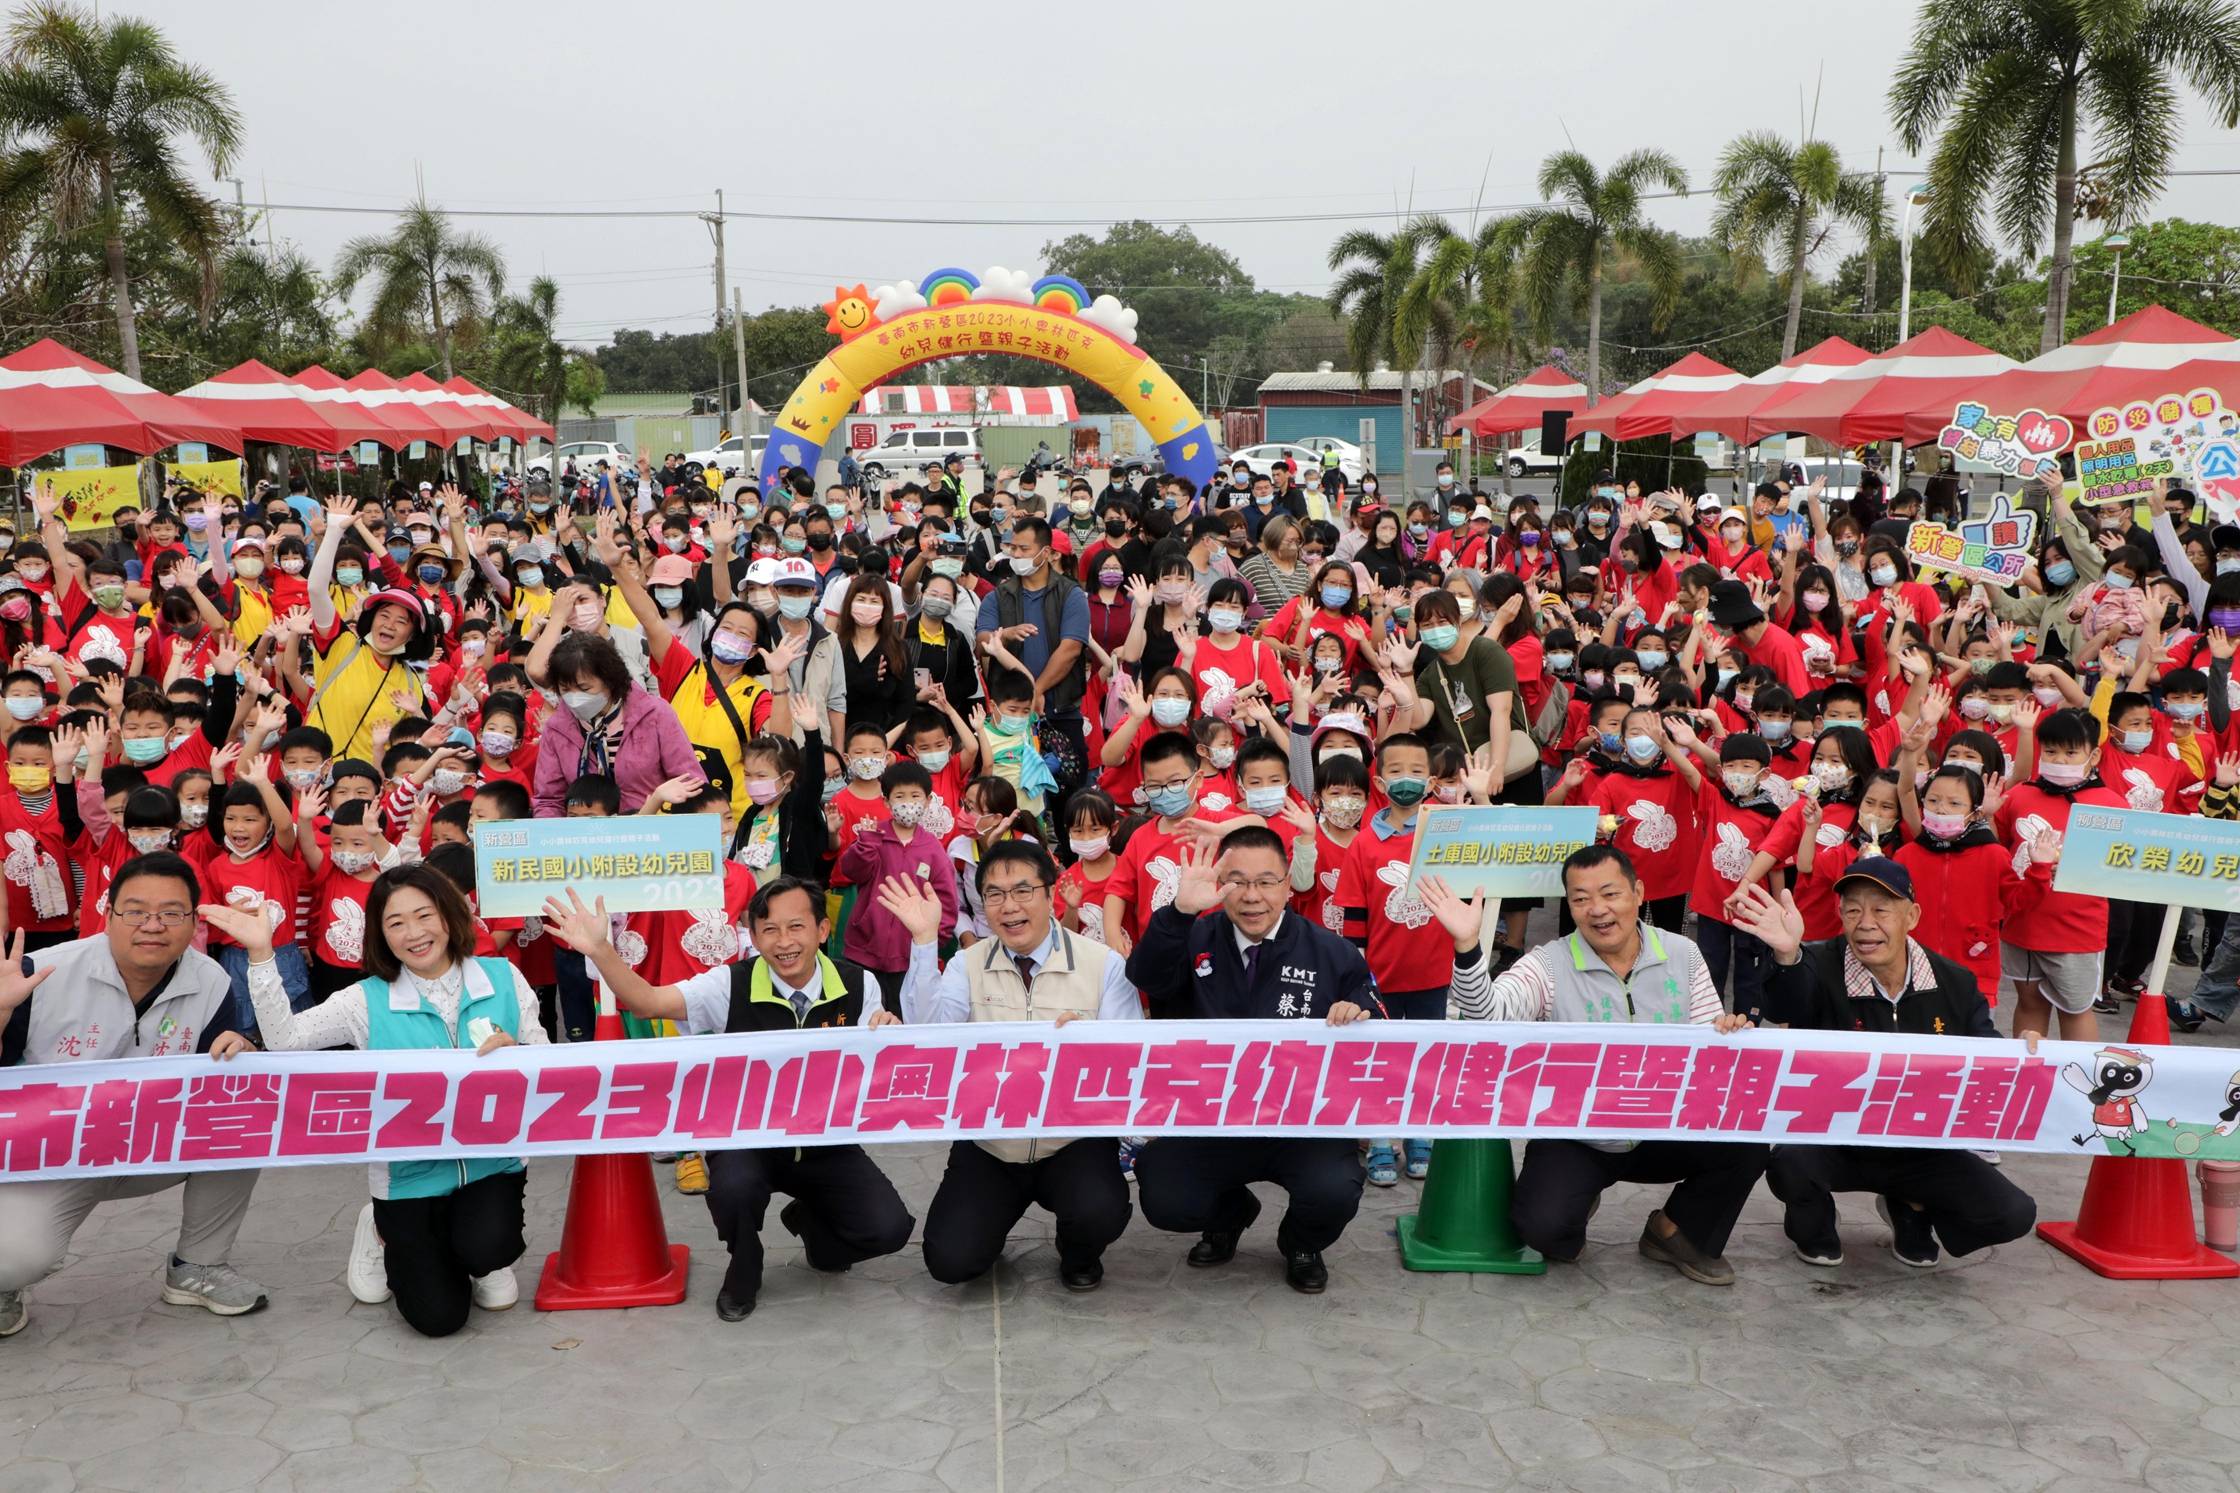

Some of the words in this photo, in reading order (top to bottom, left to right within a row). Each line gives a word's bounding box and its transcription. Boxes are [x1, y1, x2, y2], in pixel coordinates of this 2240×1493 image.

[1956, 404, 2018, 441] 家家有
[2081, 452, 2137, 474] 照明用品
[2201, 446, 2238, 478] 公
[1993, 521, 2018, 546] 讚
[1910, 523, 2025, 577] 新營區公所
[492, 850, 714, 882] 新民國小附設幼兒園
[2105, 842, 2240, 880] 欣榮幼兒
[1281, 965, 1317, 981] KMT
[1276, 993, 1299, 1017] 蔡
[1301, 989, 1313, 1018] 台南
[57, 1036, 81, 1057] 沈
[86, 1023, 100, 1049] 主任
